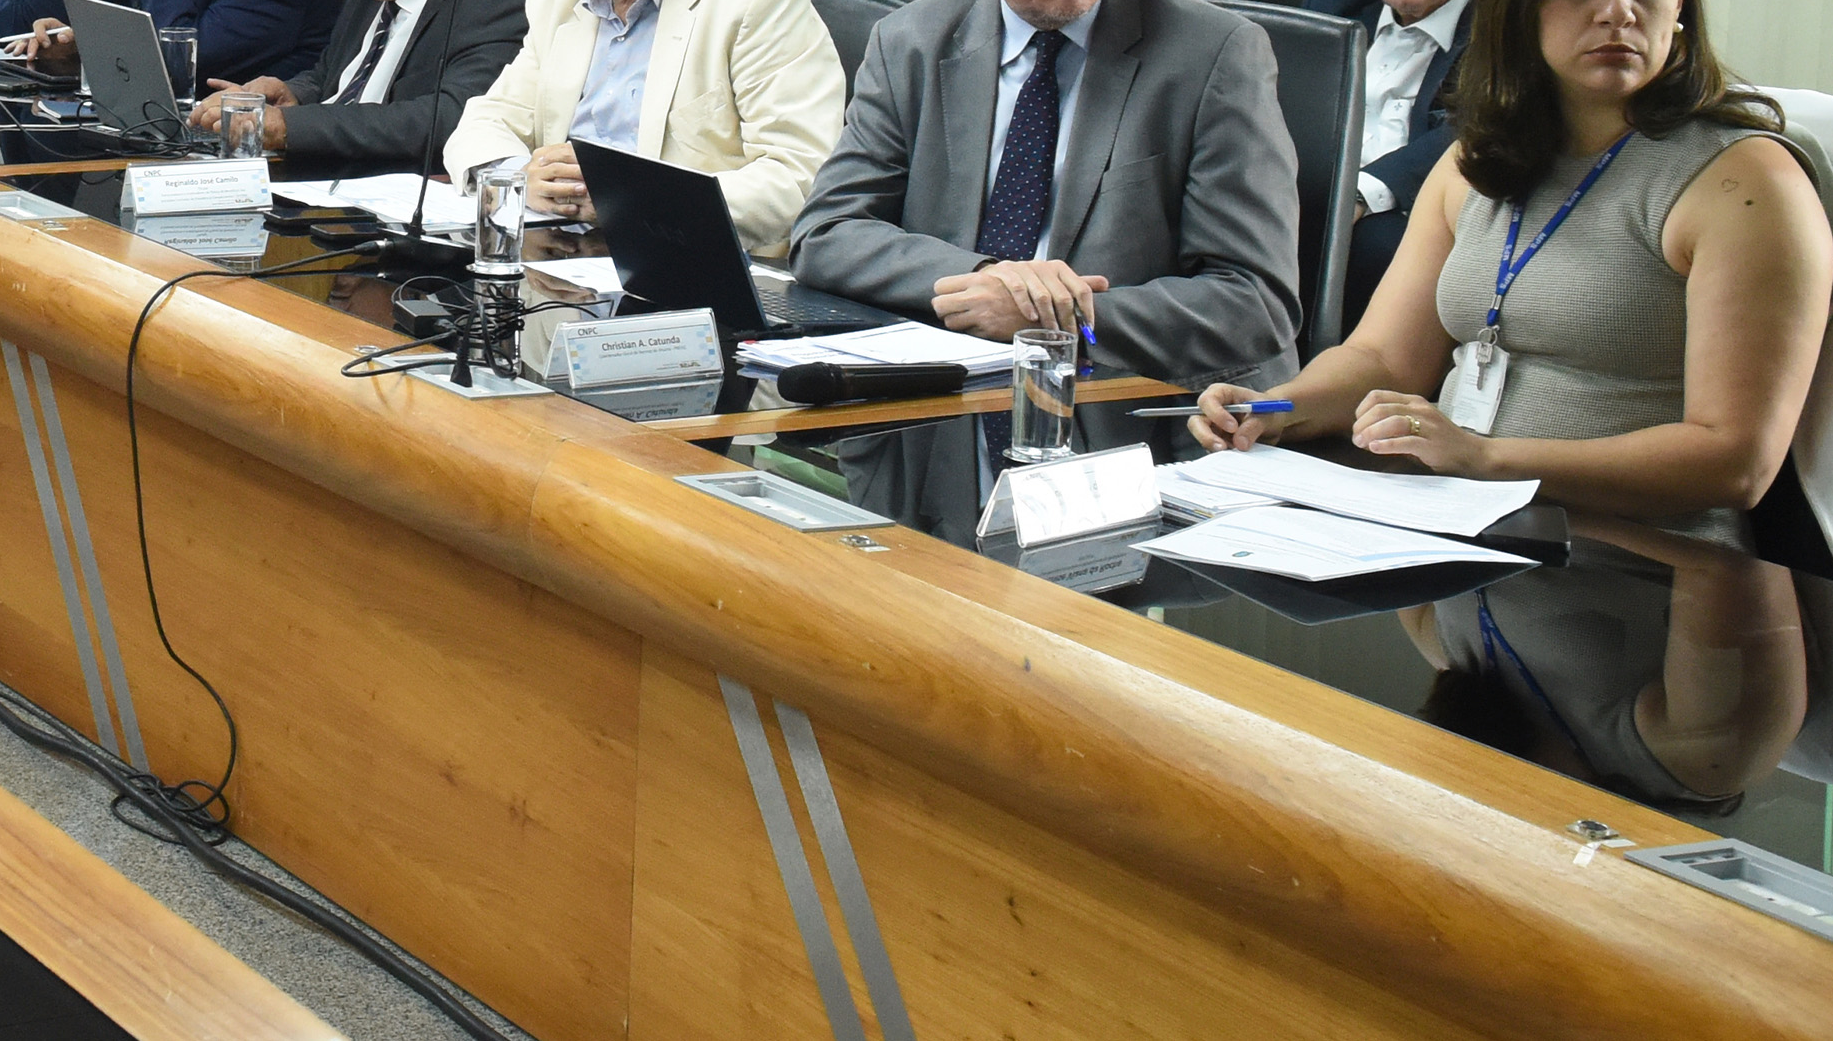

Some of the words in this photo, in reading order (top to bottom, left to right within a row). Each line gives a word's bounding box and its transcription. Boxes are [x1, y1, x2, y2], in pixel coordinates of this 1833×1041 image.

[144, 169, 162, 177] CNPC
[165, 178, 199, 188] Reginaldo
[200, 176, 214, 185] José
[215, 175, 239, 184] Camilo
[1530, 232, 1547, 249] MPS
[1499, 272, 1515, 290] MPS
[577, 327, 598, 337] CNPC
[601, 340, 637, 352] Christian
[638, 339, 647, 348] A.
[648, 335, 681, 347] Catunda
